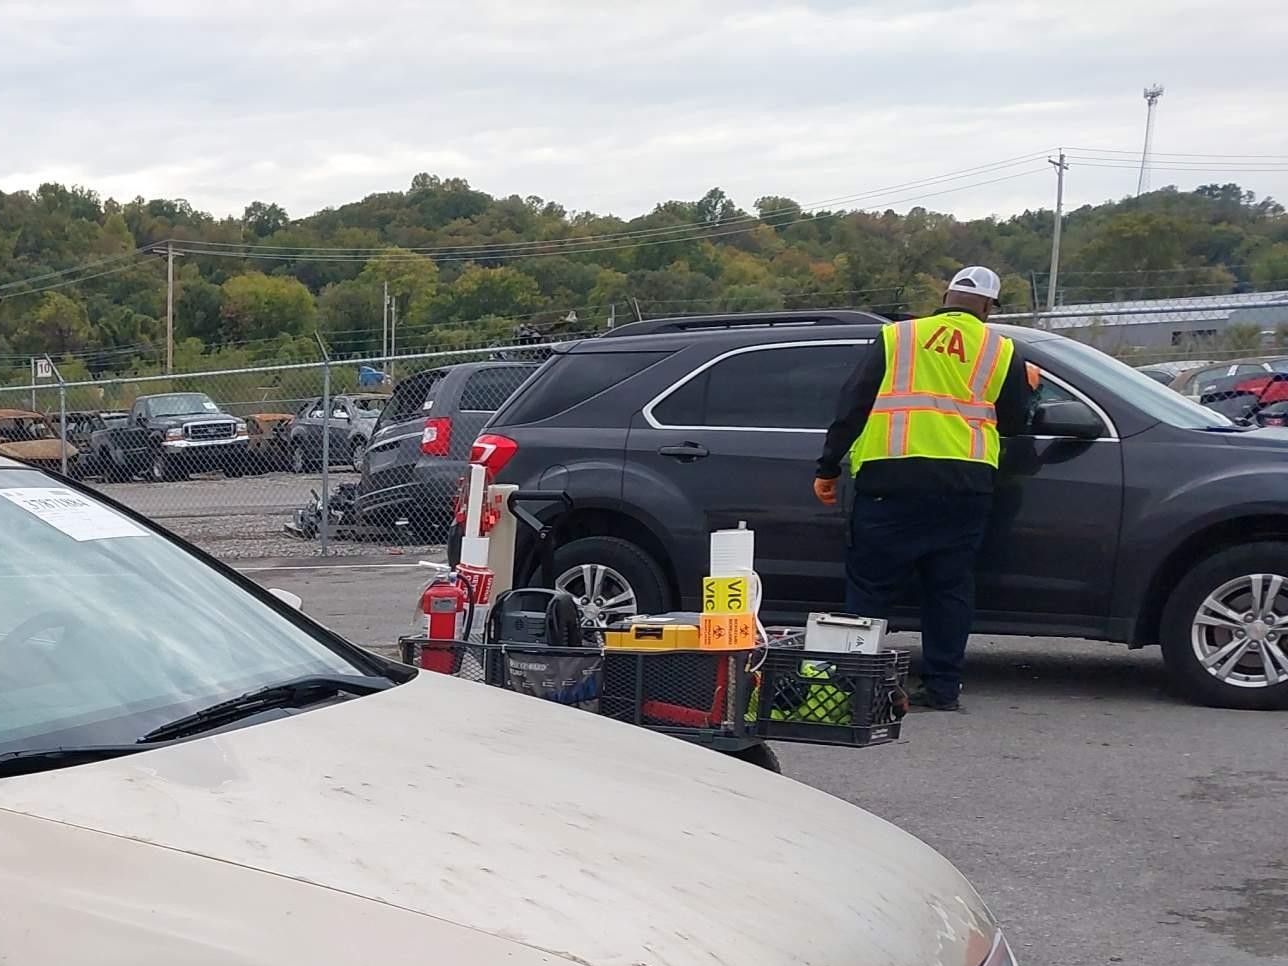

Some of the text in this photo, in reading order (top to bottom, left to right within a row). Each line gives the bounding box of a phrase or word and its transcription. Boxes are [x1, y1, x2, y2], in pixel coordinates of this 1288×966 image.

[39, 363, 50, 374] 10
[705, 581, 715, 610] VIC
[727, 580, 742, 610] VIC
